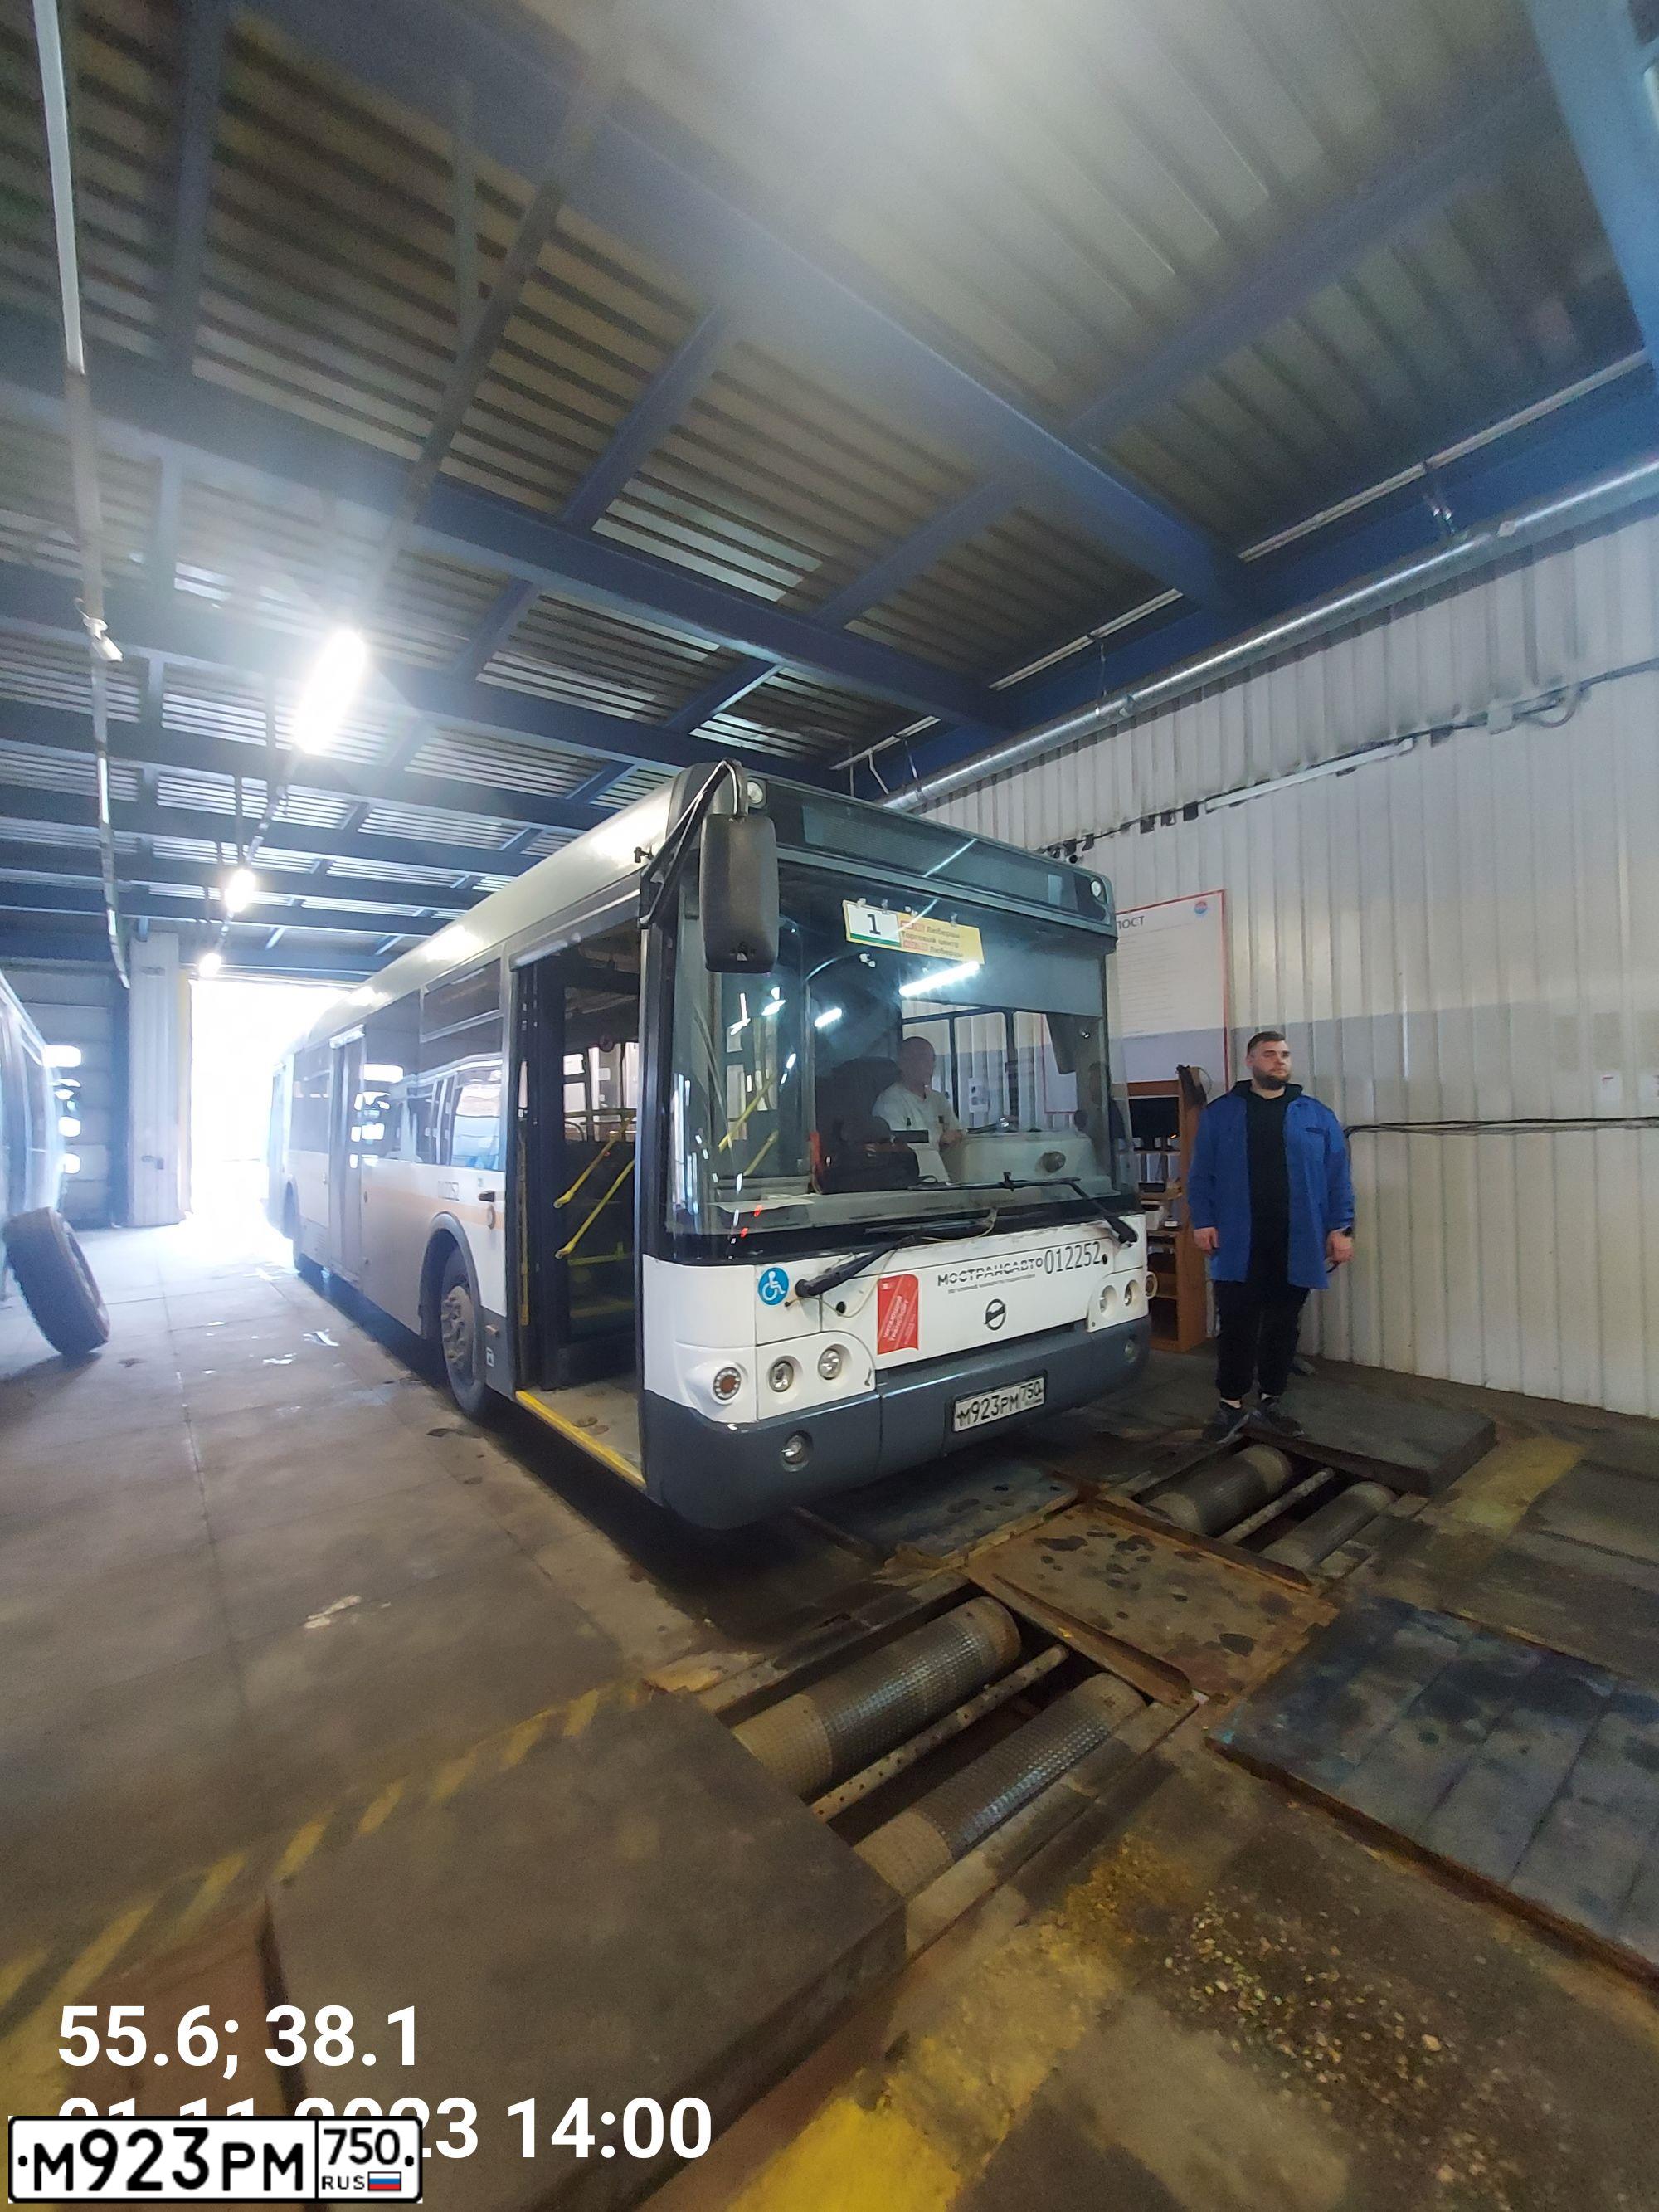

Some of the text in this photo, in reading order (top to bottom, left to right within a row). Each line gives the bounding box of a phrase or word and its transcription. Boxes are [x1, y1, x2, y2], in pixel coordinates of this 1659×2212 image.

[867, 914, 881, 935] 1
[937, 1257, 1044, 1286] МОСТРАНСАВТО
[1044, 1241, 1100, 1274] 012252
